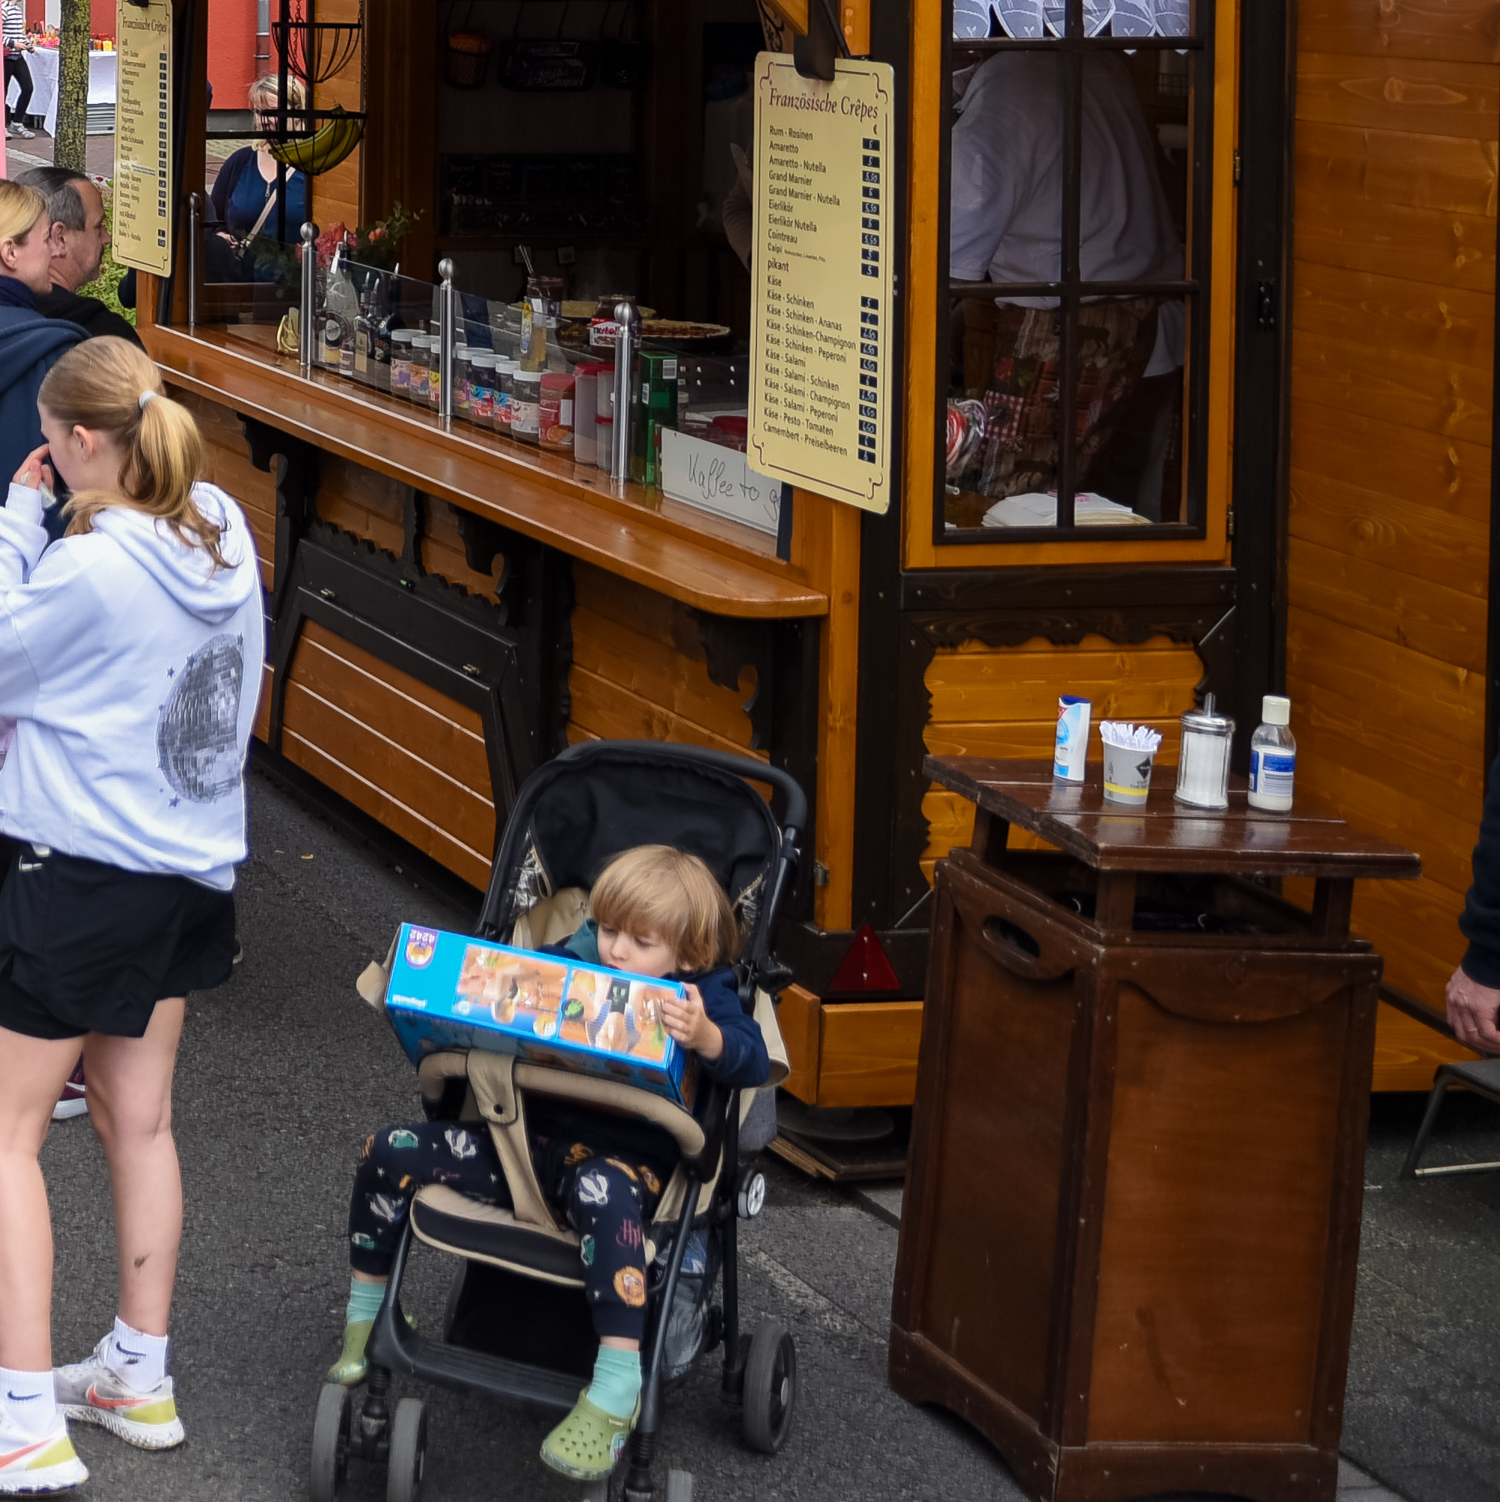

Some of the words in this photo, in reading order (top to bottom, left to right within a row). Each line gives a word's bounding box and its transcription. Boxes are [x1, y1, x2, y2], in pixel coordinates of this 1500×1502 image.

[769, 87, 837, 114] Französische
[841, 96, 878, 122] Crêpes
[770, 125, 784, 136] Rum
[789, 128, 813, 140] Rosinen
[769, 141, 799, 154] Amaretto
[769, 156, 798, 169] Amaretto
[804, 160, 826, 173] Nutella
[769, 170, 787, 182] Grand
[789, 174, 812, 186] Marnier
[769, 184, 787, 197] Grand
[789, 188, 812, 202] Marnier
[817, 193, 840, 206] Nutella
[769, 199, 794, 212] Eierlikör
[769, 214, 793, 227] Eierlikör
[795, 219, 817, 232] Nutella
[768, 228, 798, 243] Cointreau
[768, 243, 782, 254] Caipi
[768, 258, 789, 272] pikant
[768, 275, 782, 287] Käse
[767, 289, 781, 301] Käse
[786, 293, 814, 309] Schinken
[766, 318, 781, 331] Käse
[767, 304, 781, 316] Käse
[786, 308, 814, 324] Schinken
[818, 317, 842, 331] Ananas
[766, 333, 780, 346] Käse
[785, 338, 813, 354] Schinken
[818, 347, 847, 363] Peperoni
[765, 348, 780, 361] Käse
[785, 353, 806, 367] Salami
[765, 362, 779, 375] Käse
[785, 368, 805, 383] Salami
[811, 375, 839, 391] Schinken
[765, 377, 779, 390] Käse
[784, 383, 805, 397] Salami
[810, 390, 850, 410] Champignon
[764, 392, 778, 405] Käse
[784, 397, 805, 412] Salami
[810, 405, 838, 422] Peperoni
[764, 407, 778, 420] Käse
[784, 412, 800, 426] Pesto
[805, 419, 834, 436] Tomaten
[763, 421, 799, 441] Camembert
[804, 434, 848, 456] Preiselbeeren
[689, 453, 734, 499] Kaffee
[739, 462, 759, 501] to
[763, 489, 780, 522] g
[409, 929, 435, 944] 4242
